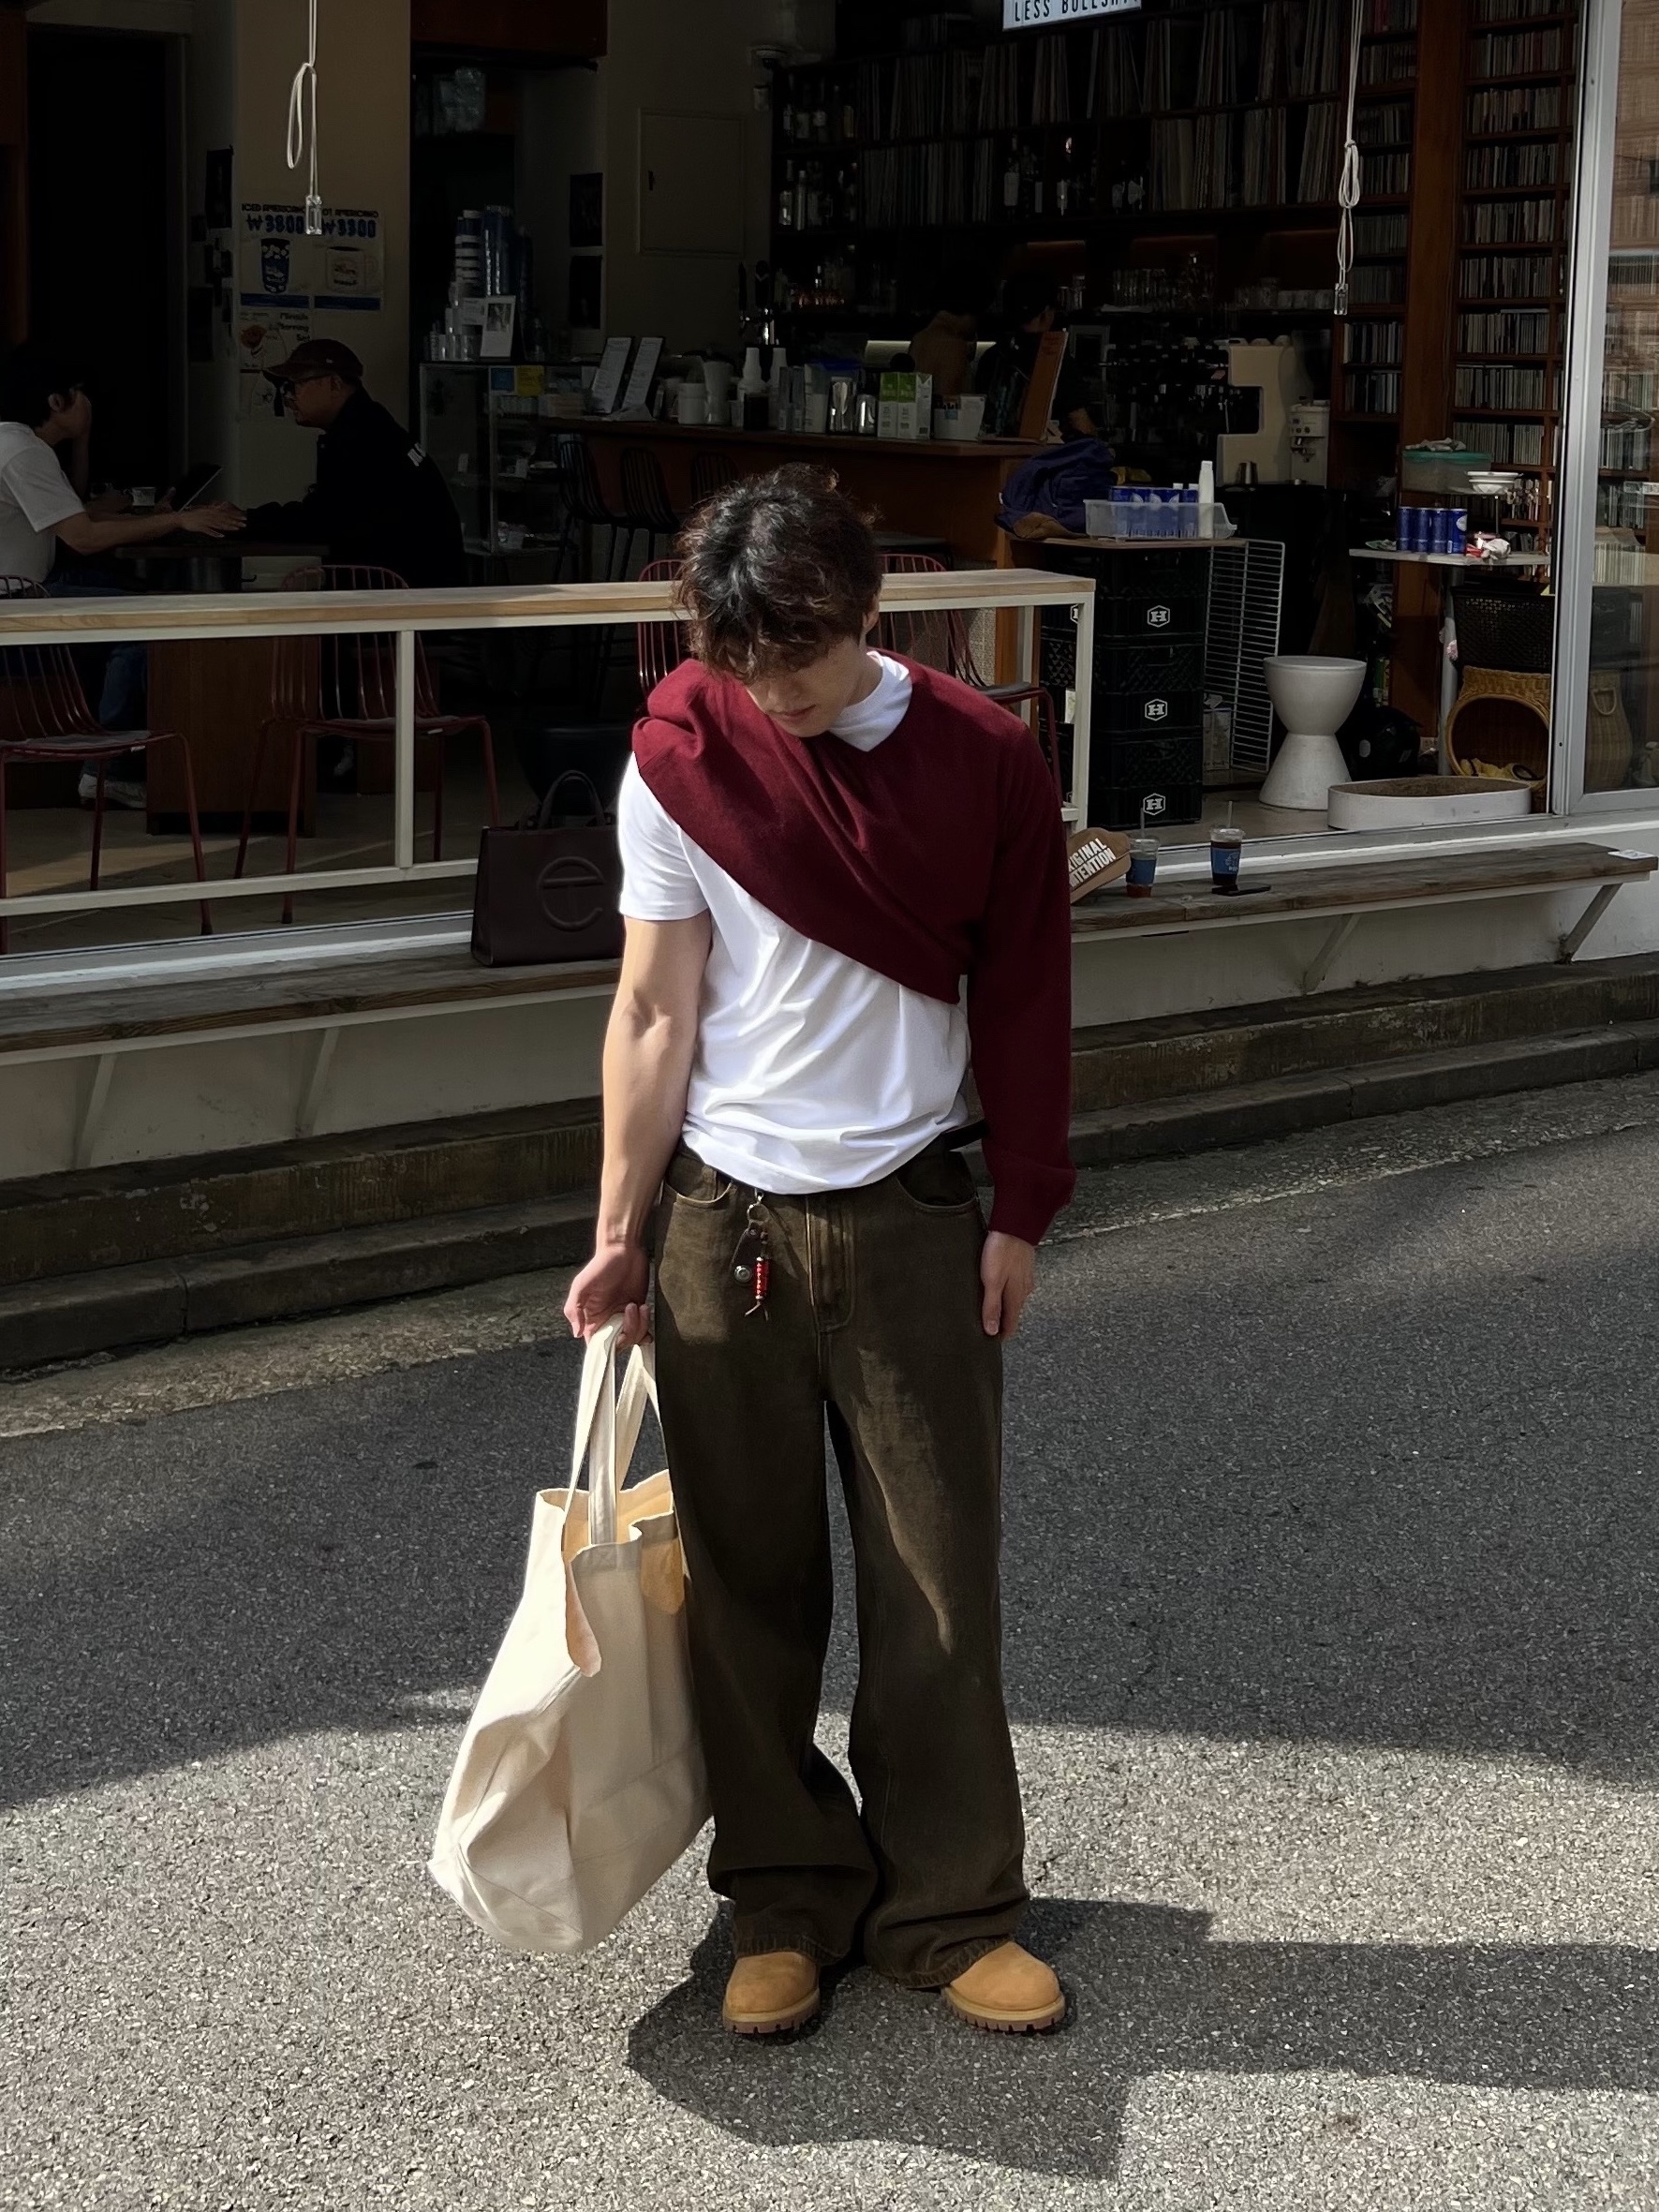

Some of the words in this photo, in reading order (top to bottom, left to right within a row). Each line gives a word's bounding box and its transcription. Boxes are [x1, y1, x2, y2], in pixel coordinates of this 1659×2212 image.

[1015, 0, 1050, 22] LESS
[1149, 610, 1167, 623] H
[1148, 703, 1165, 716] H
[1146, 797, 1163, 811] H
[1068, 837, 1107, 872] RIGINAL
[1069, 847, 1117, 887] NTENTION
